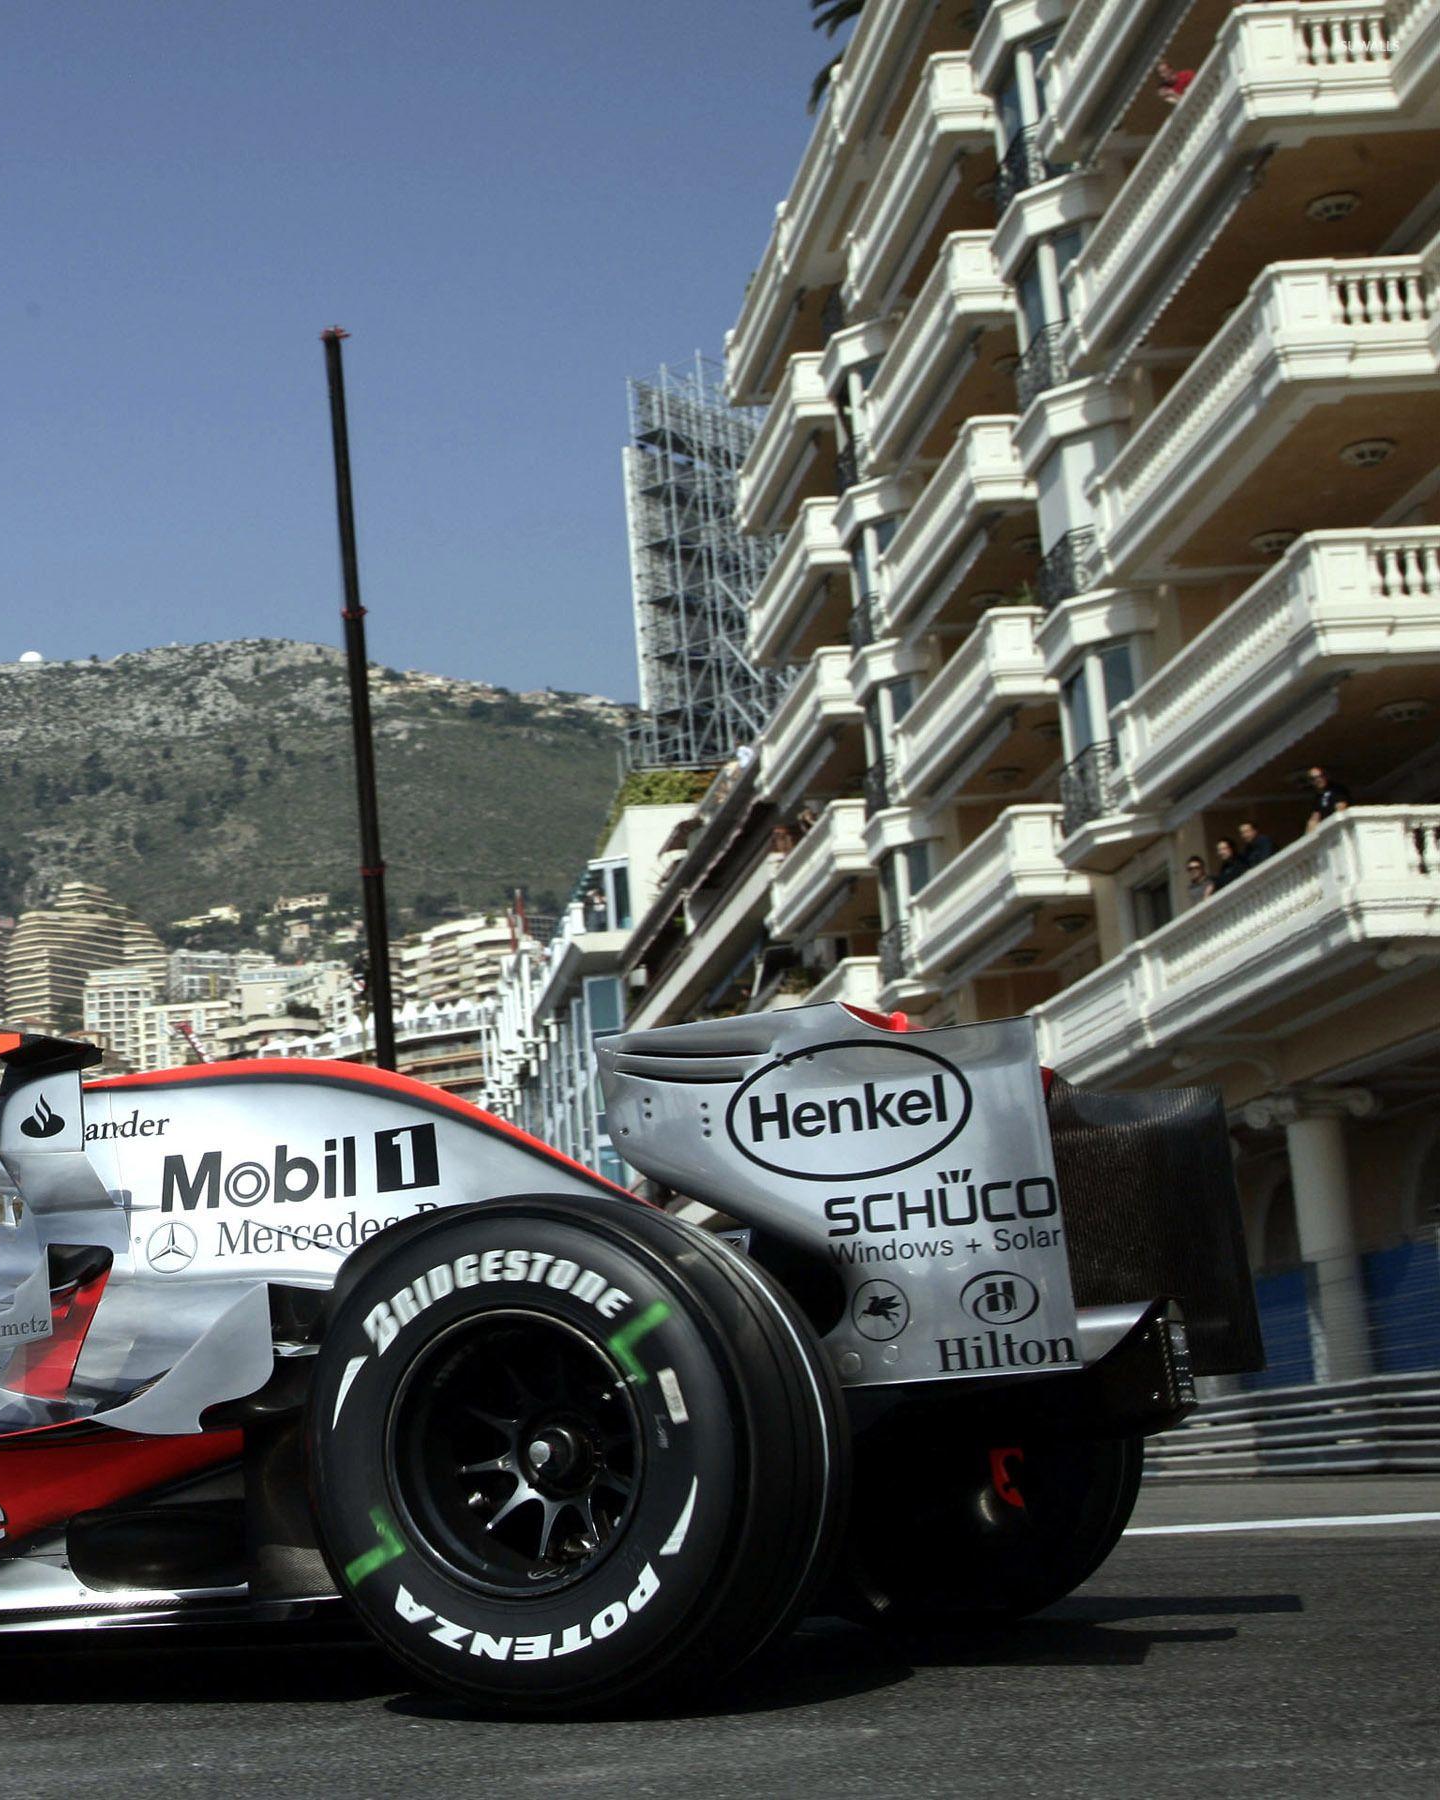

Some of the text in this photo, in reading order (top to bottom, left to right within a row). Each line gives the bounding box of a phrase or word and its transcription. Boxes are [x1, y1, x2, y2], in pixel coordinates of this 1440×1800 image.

[747, 1073, 948, 1143] Henkel
[161, 1135, 357, 1213] Mobil
[824, 1168, 1058, 1238] SCHÜCO
[828, 1238, 954, 1266] Windows
[993, 1226, 1061, 1252] Solar
[362, 1248, 633, 1358] BRIDGESTONE
[935, 1330, 1079, 1373] Hilton
[394, 1561, 662, 1662] POTENZA
